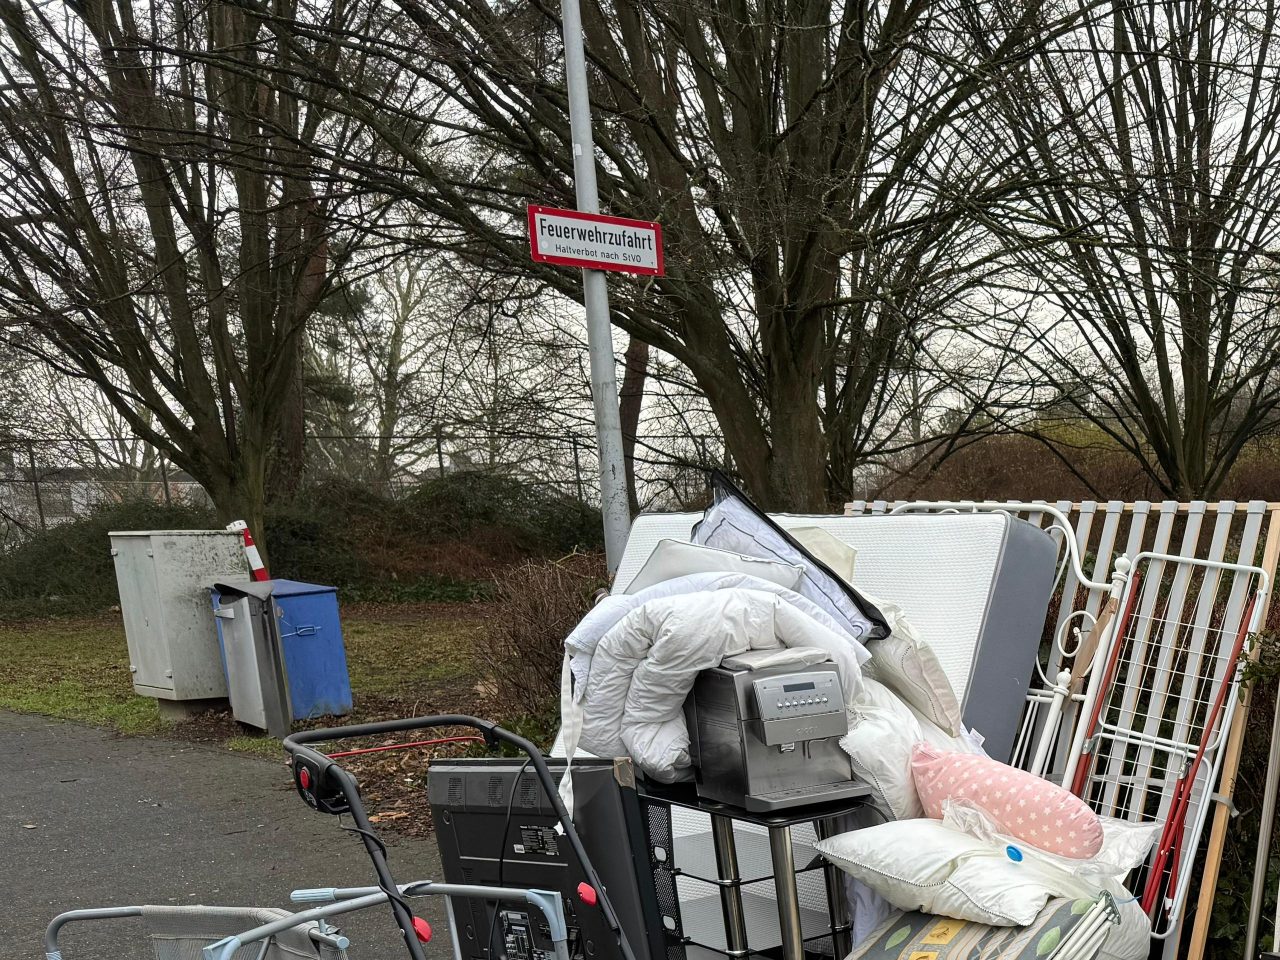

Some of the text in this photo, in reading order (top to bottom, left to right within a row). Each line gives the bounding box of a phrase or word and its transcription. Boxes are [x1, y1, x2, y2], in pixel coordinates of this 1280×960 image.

[540, 218, 652, 250] Feuerwehrzufahrt
[555, 244, 641, 263] Haltverbot nach StVO
